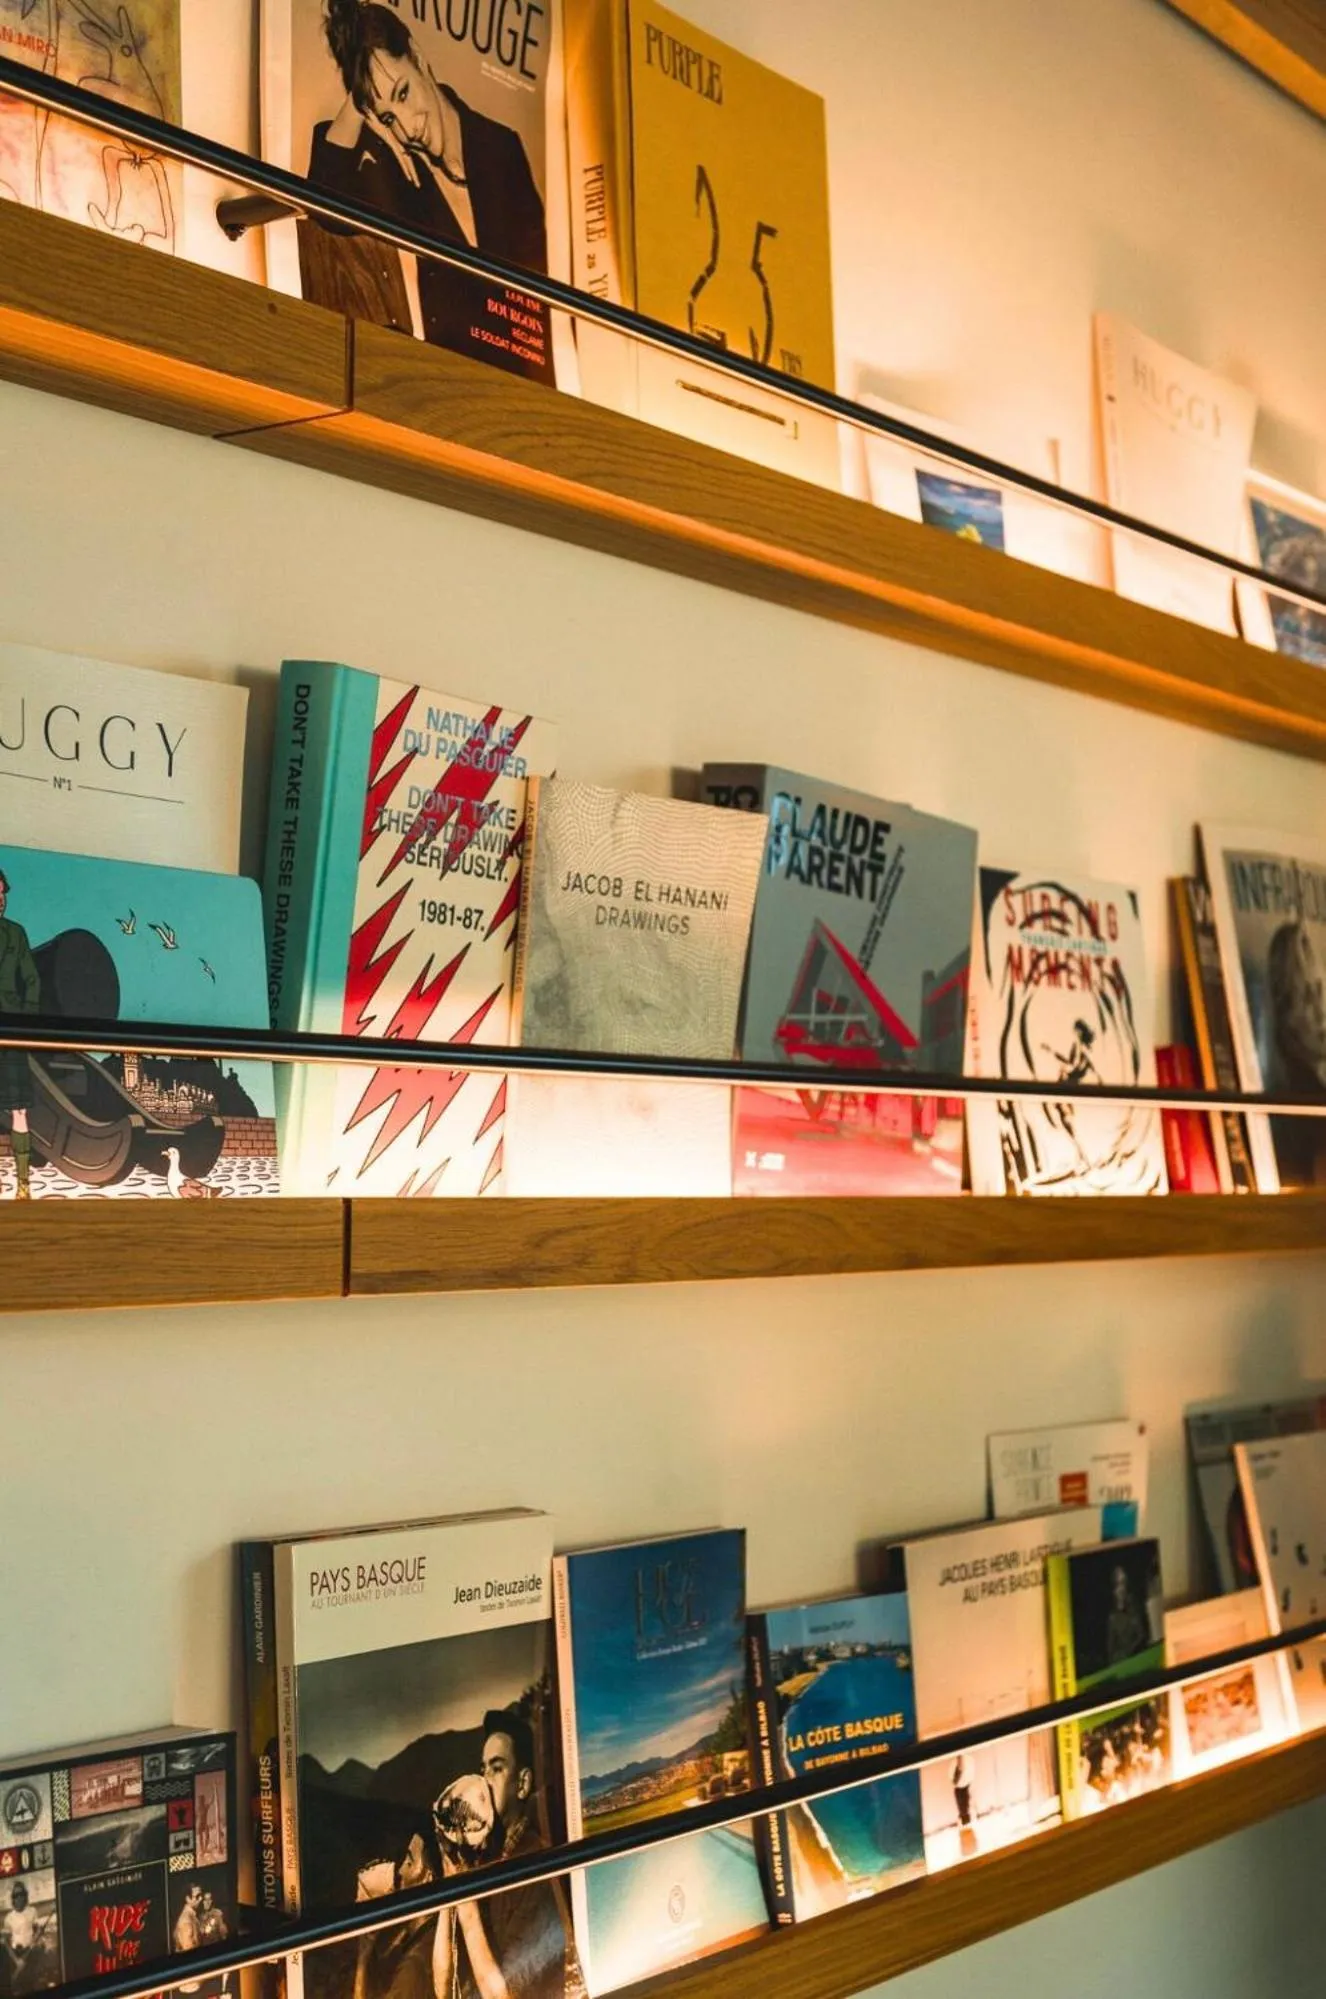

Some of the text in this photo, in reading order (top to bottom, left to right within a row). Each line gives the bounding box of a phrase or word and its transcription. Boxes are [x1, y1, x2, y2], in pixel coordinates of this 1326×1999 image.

[644, 22, 723, 106] PURPLE
[583, 164, 607, 244] PURPLE
[0, 697, 188, 778] UGGY
[403, 728, 431, 757] DU
[427, 707, 515, 750] NATHALIE
[286, 751, 304, 810] TAKE
[376, 806, 437, 840] THESE
[471, 800, 517, 830] TAKE
[771, 791, 891, 863] CLAUDE
[278, 816, 299, 887] THESE
[767, 835, 885, 903] PARENT
[561, 871, 729, 911] JACOB EL HANANI
[418, 899, 486, 931] 1981-87.
[595, 905, 690, 936] DRAWINGS
[310, 1556, 427, 1597] PAYS BASQUE
[453, 1573, 542, 1604] Jean Dieuzaide
[787, 1734, 804, 1752] LA
[844, 1712, 905, 1739] BASQUE
[259, 1755, 277, 1908] NTONS SURFEURS
